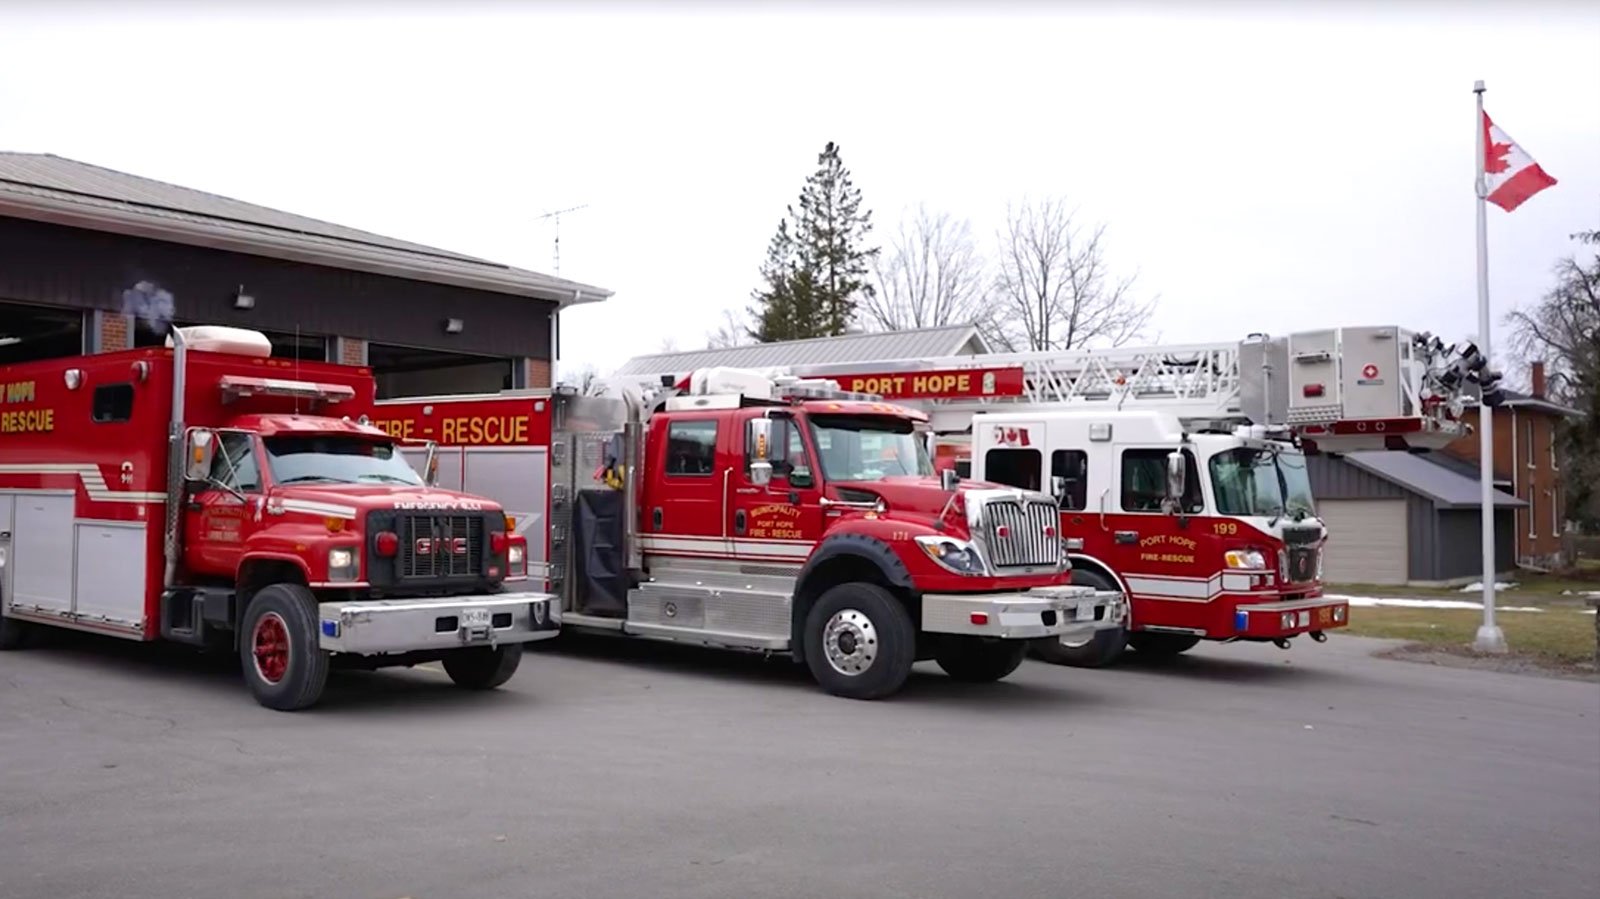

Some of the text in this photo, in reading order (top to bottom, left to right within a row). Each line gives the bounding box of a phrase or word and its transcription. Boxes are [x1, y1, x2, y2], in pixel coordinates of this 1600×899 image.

[852, 374, 971, 394] PORT HOPE
[1, 409, 54, 432] RESCUE
[442, 416, 529, 443] RESCUE
[750, 503, 801, 518] MUNICIPALITY
[757, 520, 795, 529] PORT HOPE
[1213, 523, 1238, 535] 199
[749, 528, 767, 538] FIRE
[772, 528, 803, 539] RESCUE
[1140, 534, 1197, 551] PORT HOPE
